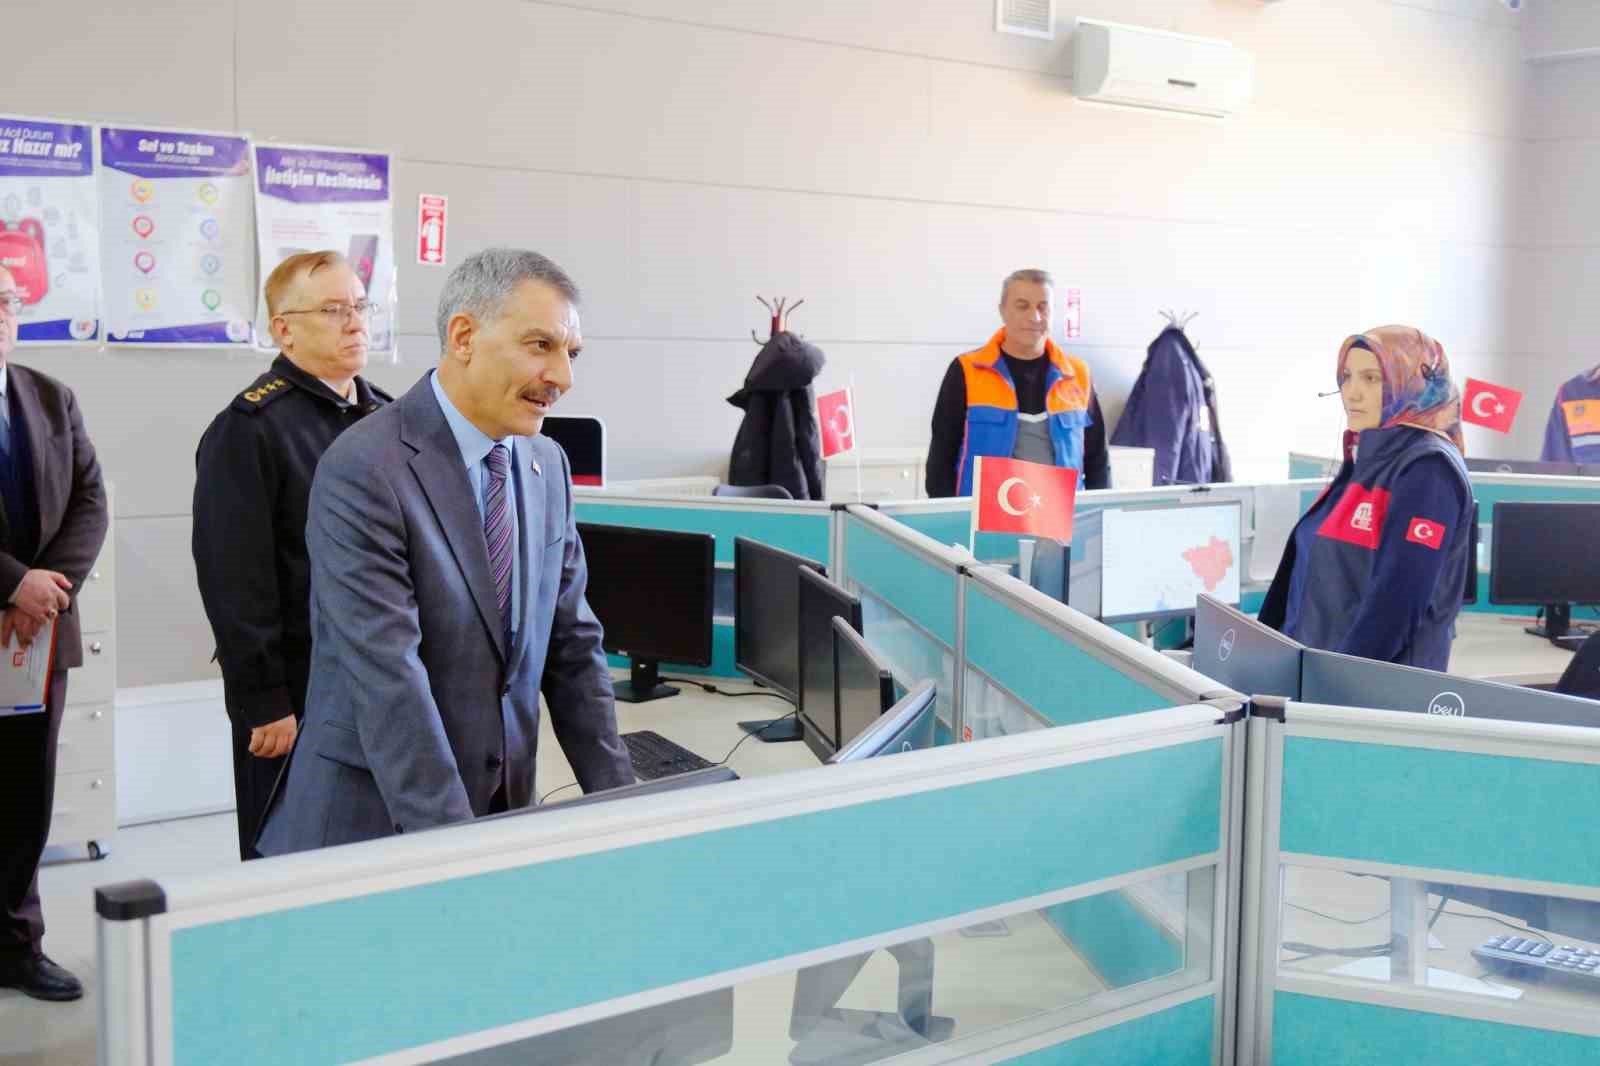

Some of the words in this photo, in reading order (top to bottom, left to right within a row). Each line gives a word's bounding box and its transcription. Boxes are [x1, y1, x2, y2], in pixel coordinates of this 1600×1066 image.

[23, 128, 54, 141] Durum
[138, 139, 159, 153] Sel
[160, 142, 175, 154] ve
